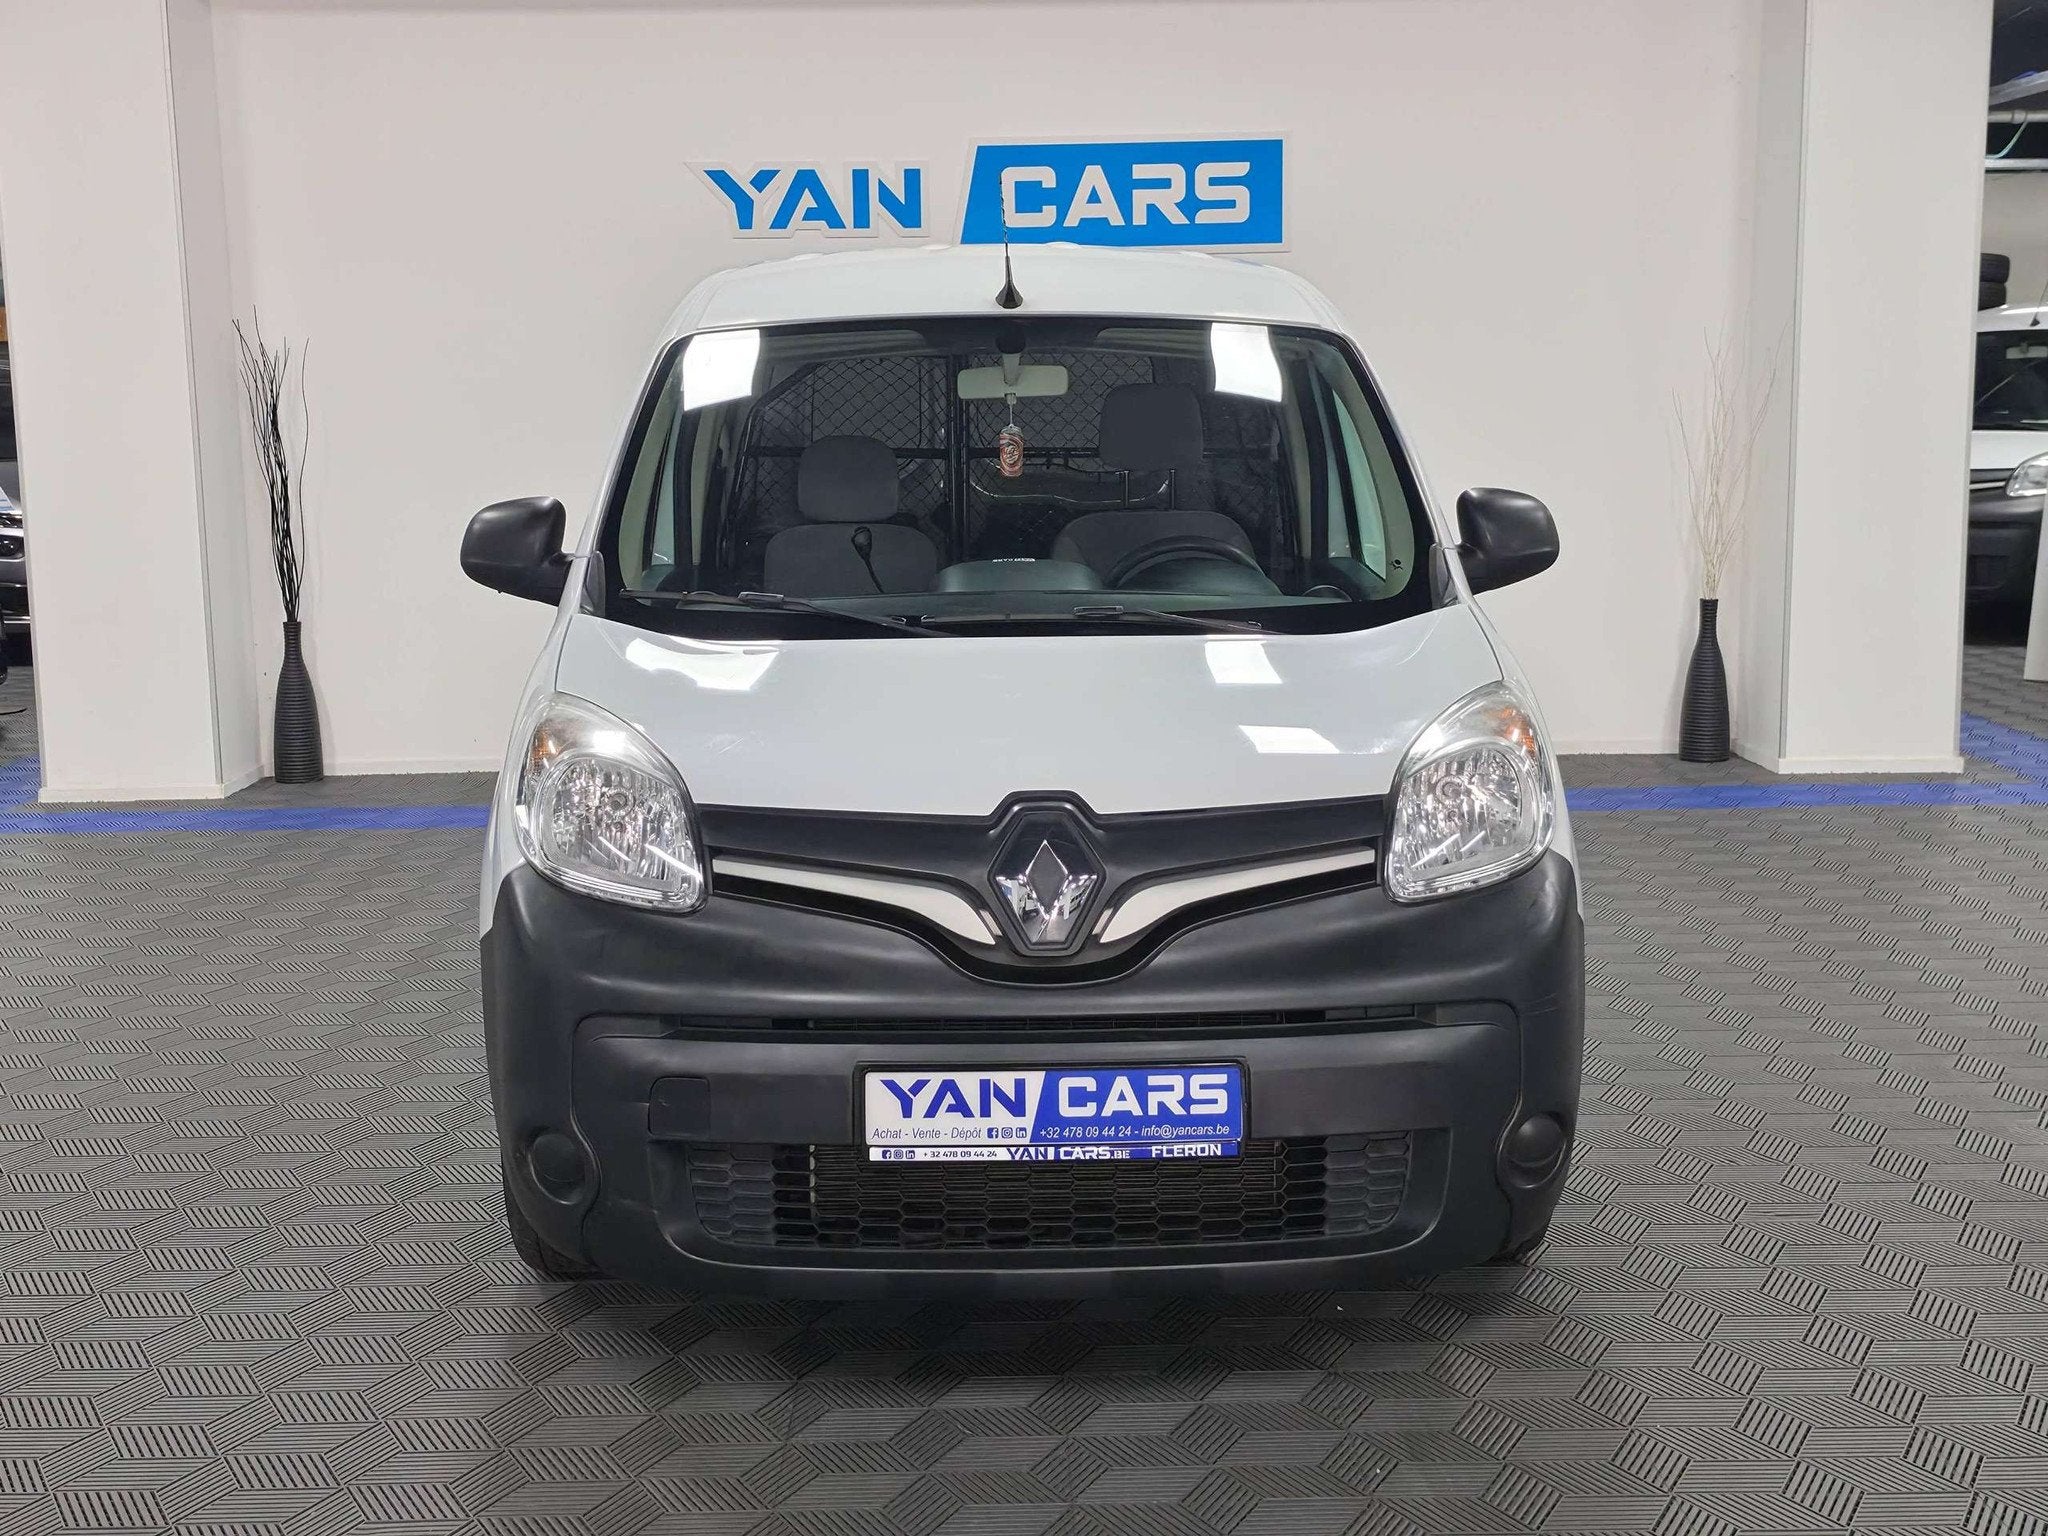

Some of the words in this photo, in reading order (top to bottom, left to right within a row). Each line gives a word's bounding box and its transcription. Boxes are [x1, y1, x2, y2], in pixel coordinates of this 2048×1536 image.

[703, 168, 922, 231] YAN
[1001, 161, 1251, 229] CARS
[880, 1078, 1026, 1119] YAN
[1058, 1073, 1229, 1118] CARS
[871, 1127, 902, 1140] Achat
[912, 1128, 941, 1139] Vente
[951, 1126, 982, 1141] Dépôt
[1040, 1127, 1060, 1139] +32
[1063, 1127, 1083, 1138] 478
[1086, 1126, 1099, 1138] 09
[1102, 1126, 1115, 1137] 44
[1118, 1126, 1132, 1137] 24
[1141, 1123, 1230, 1139] info@yancars.be
[930, 1150, 940, 1158] 32
[942, 1150, 958, 1158] 478
[960, 1150, 972, 1158] 09
[973, 1150, 985, 1158] 44
[986, 1150, 998, 1158] 24
[1006, 1147, 1048, 1160] YAN
[1151, 1143, 1222, 1158] FLERON
